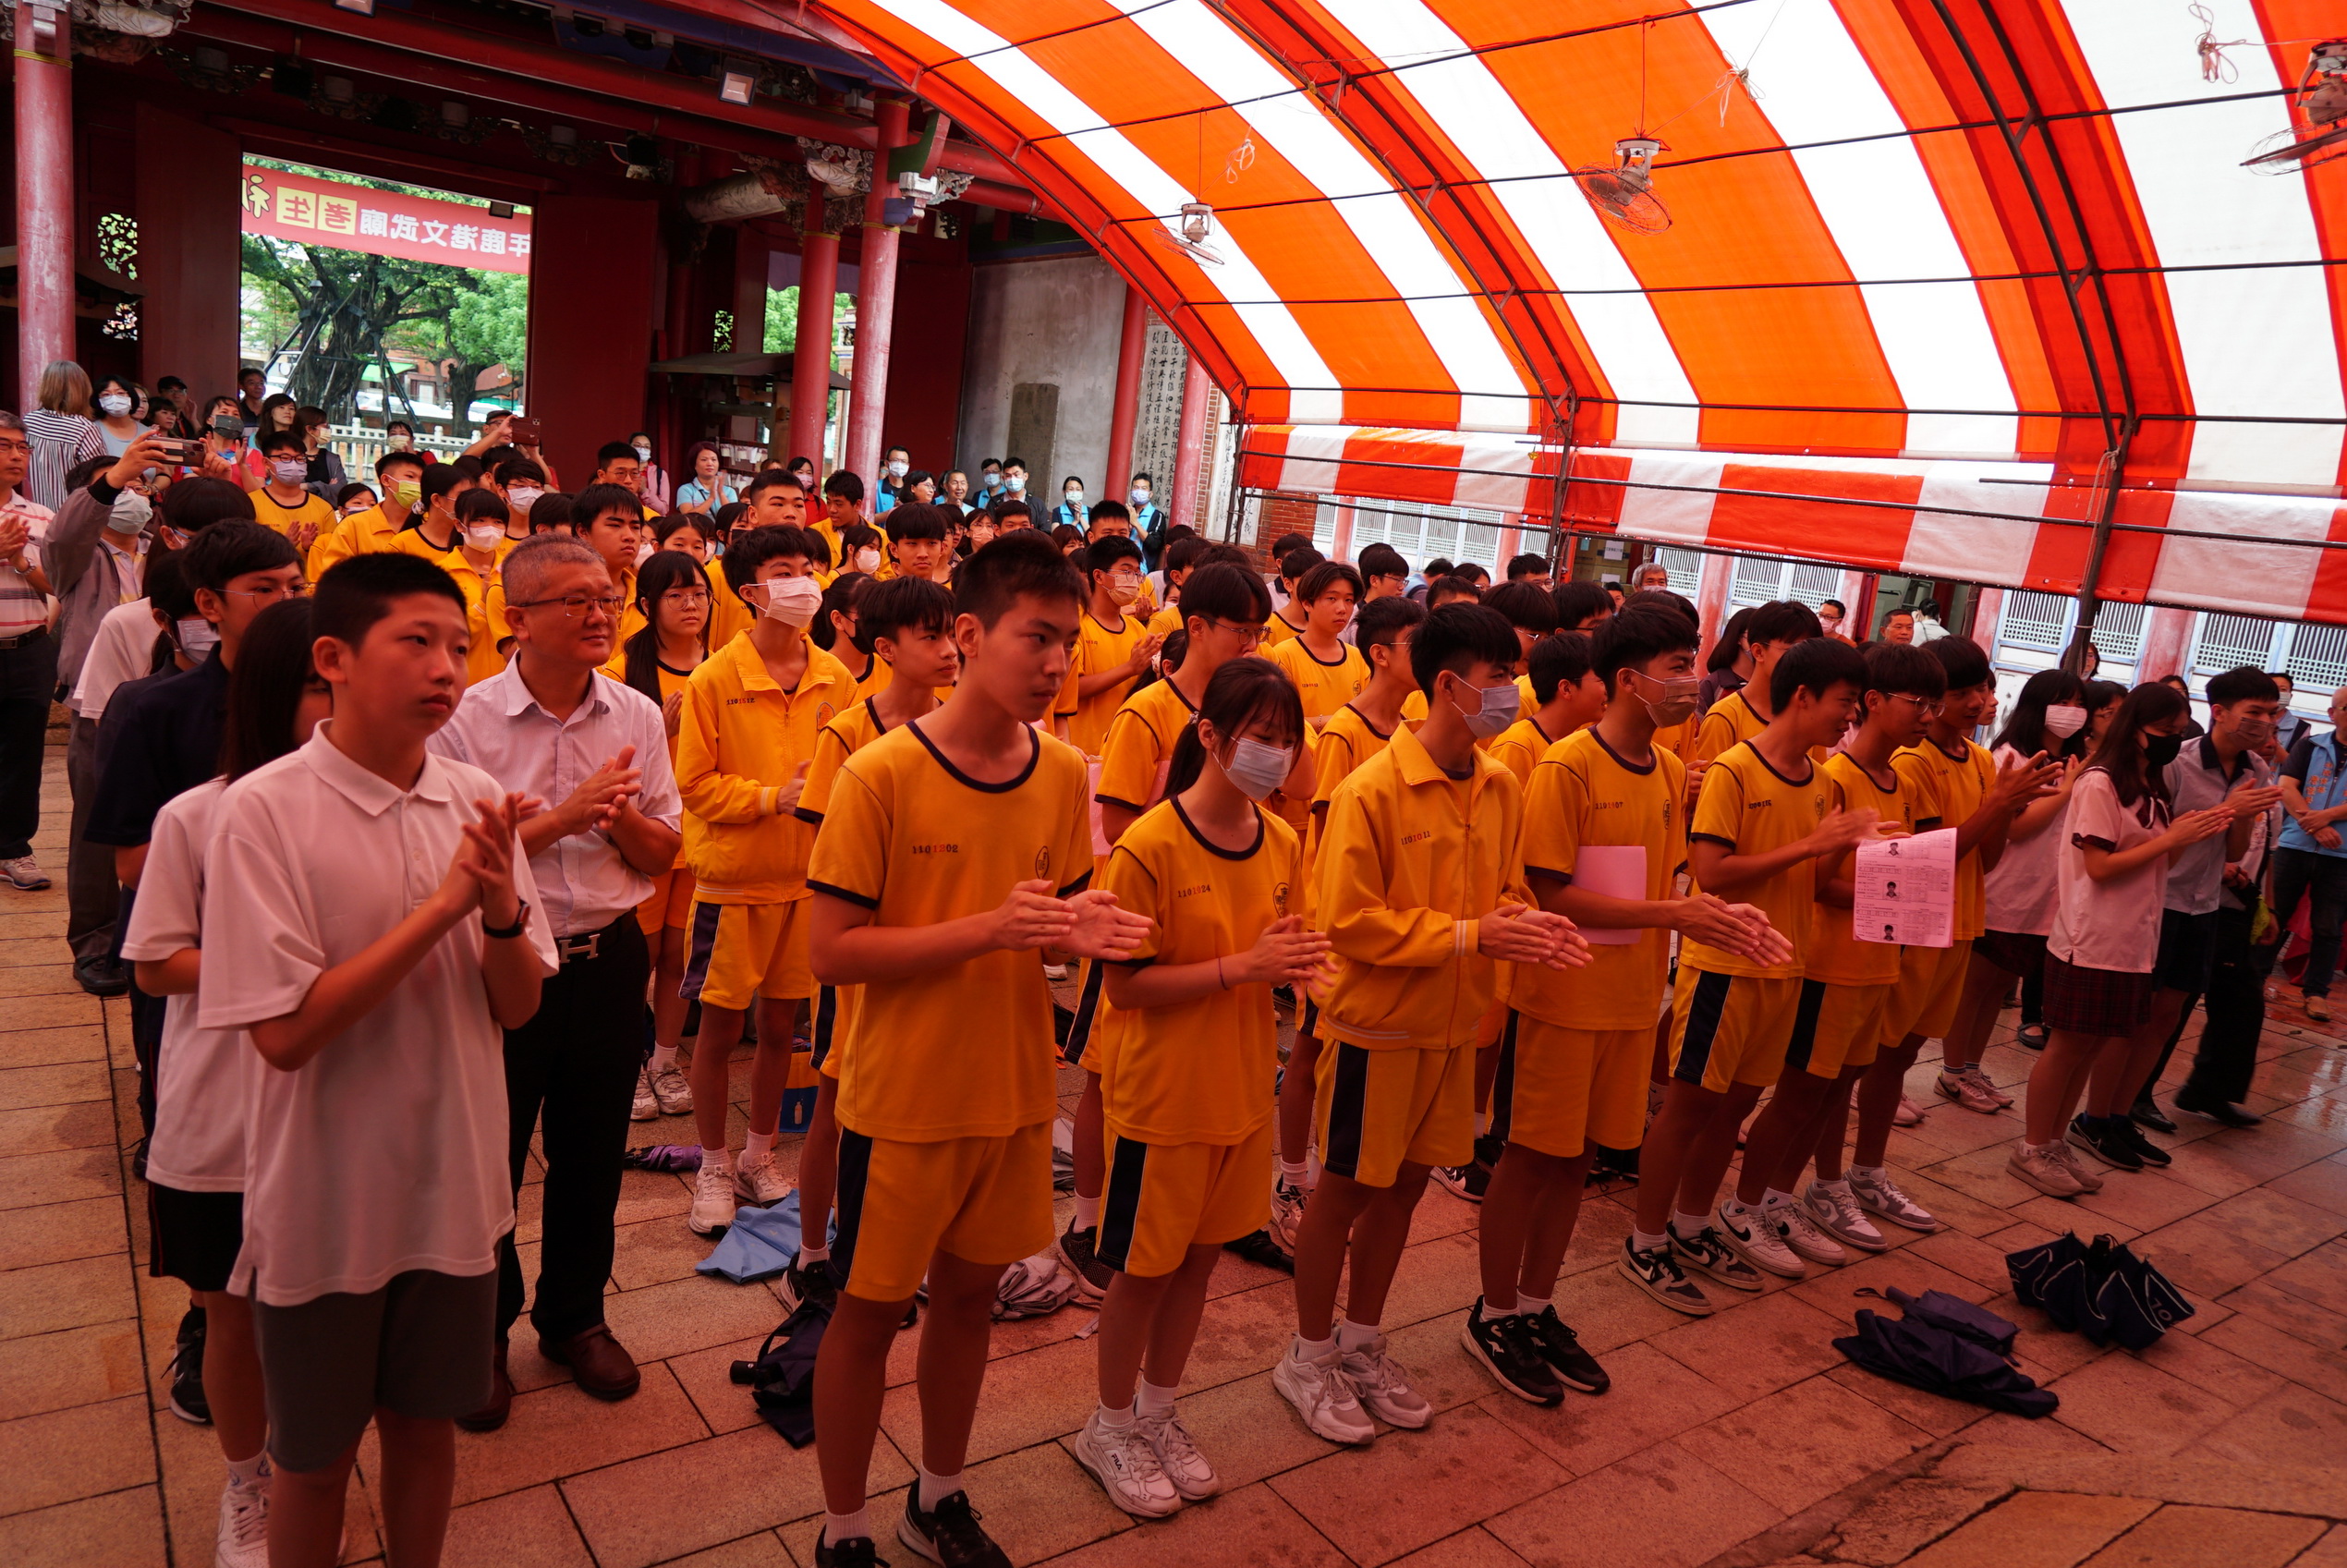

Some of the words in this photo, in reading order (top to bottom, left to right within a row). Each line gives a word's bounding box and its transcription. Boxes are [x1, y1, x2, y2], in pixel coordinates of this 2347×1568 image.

[912, 844, 958, 854] 1101202
[1177, 884, 1211, 898] 1101024
[1111, 1453, 1123, 1471] FILA
